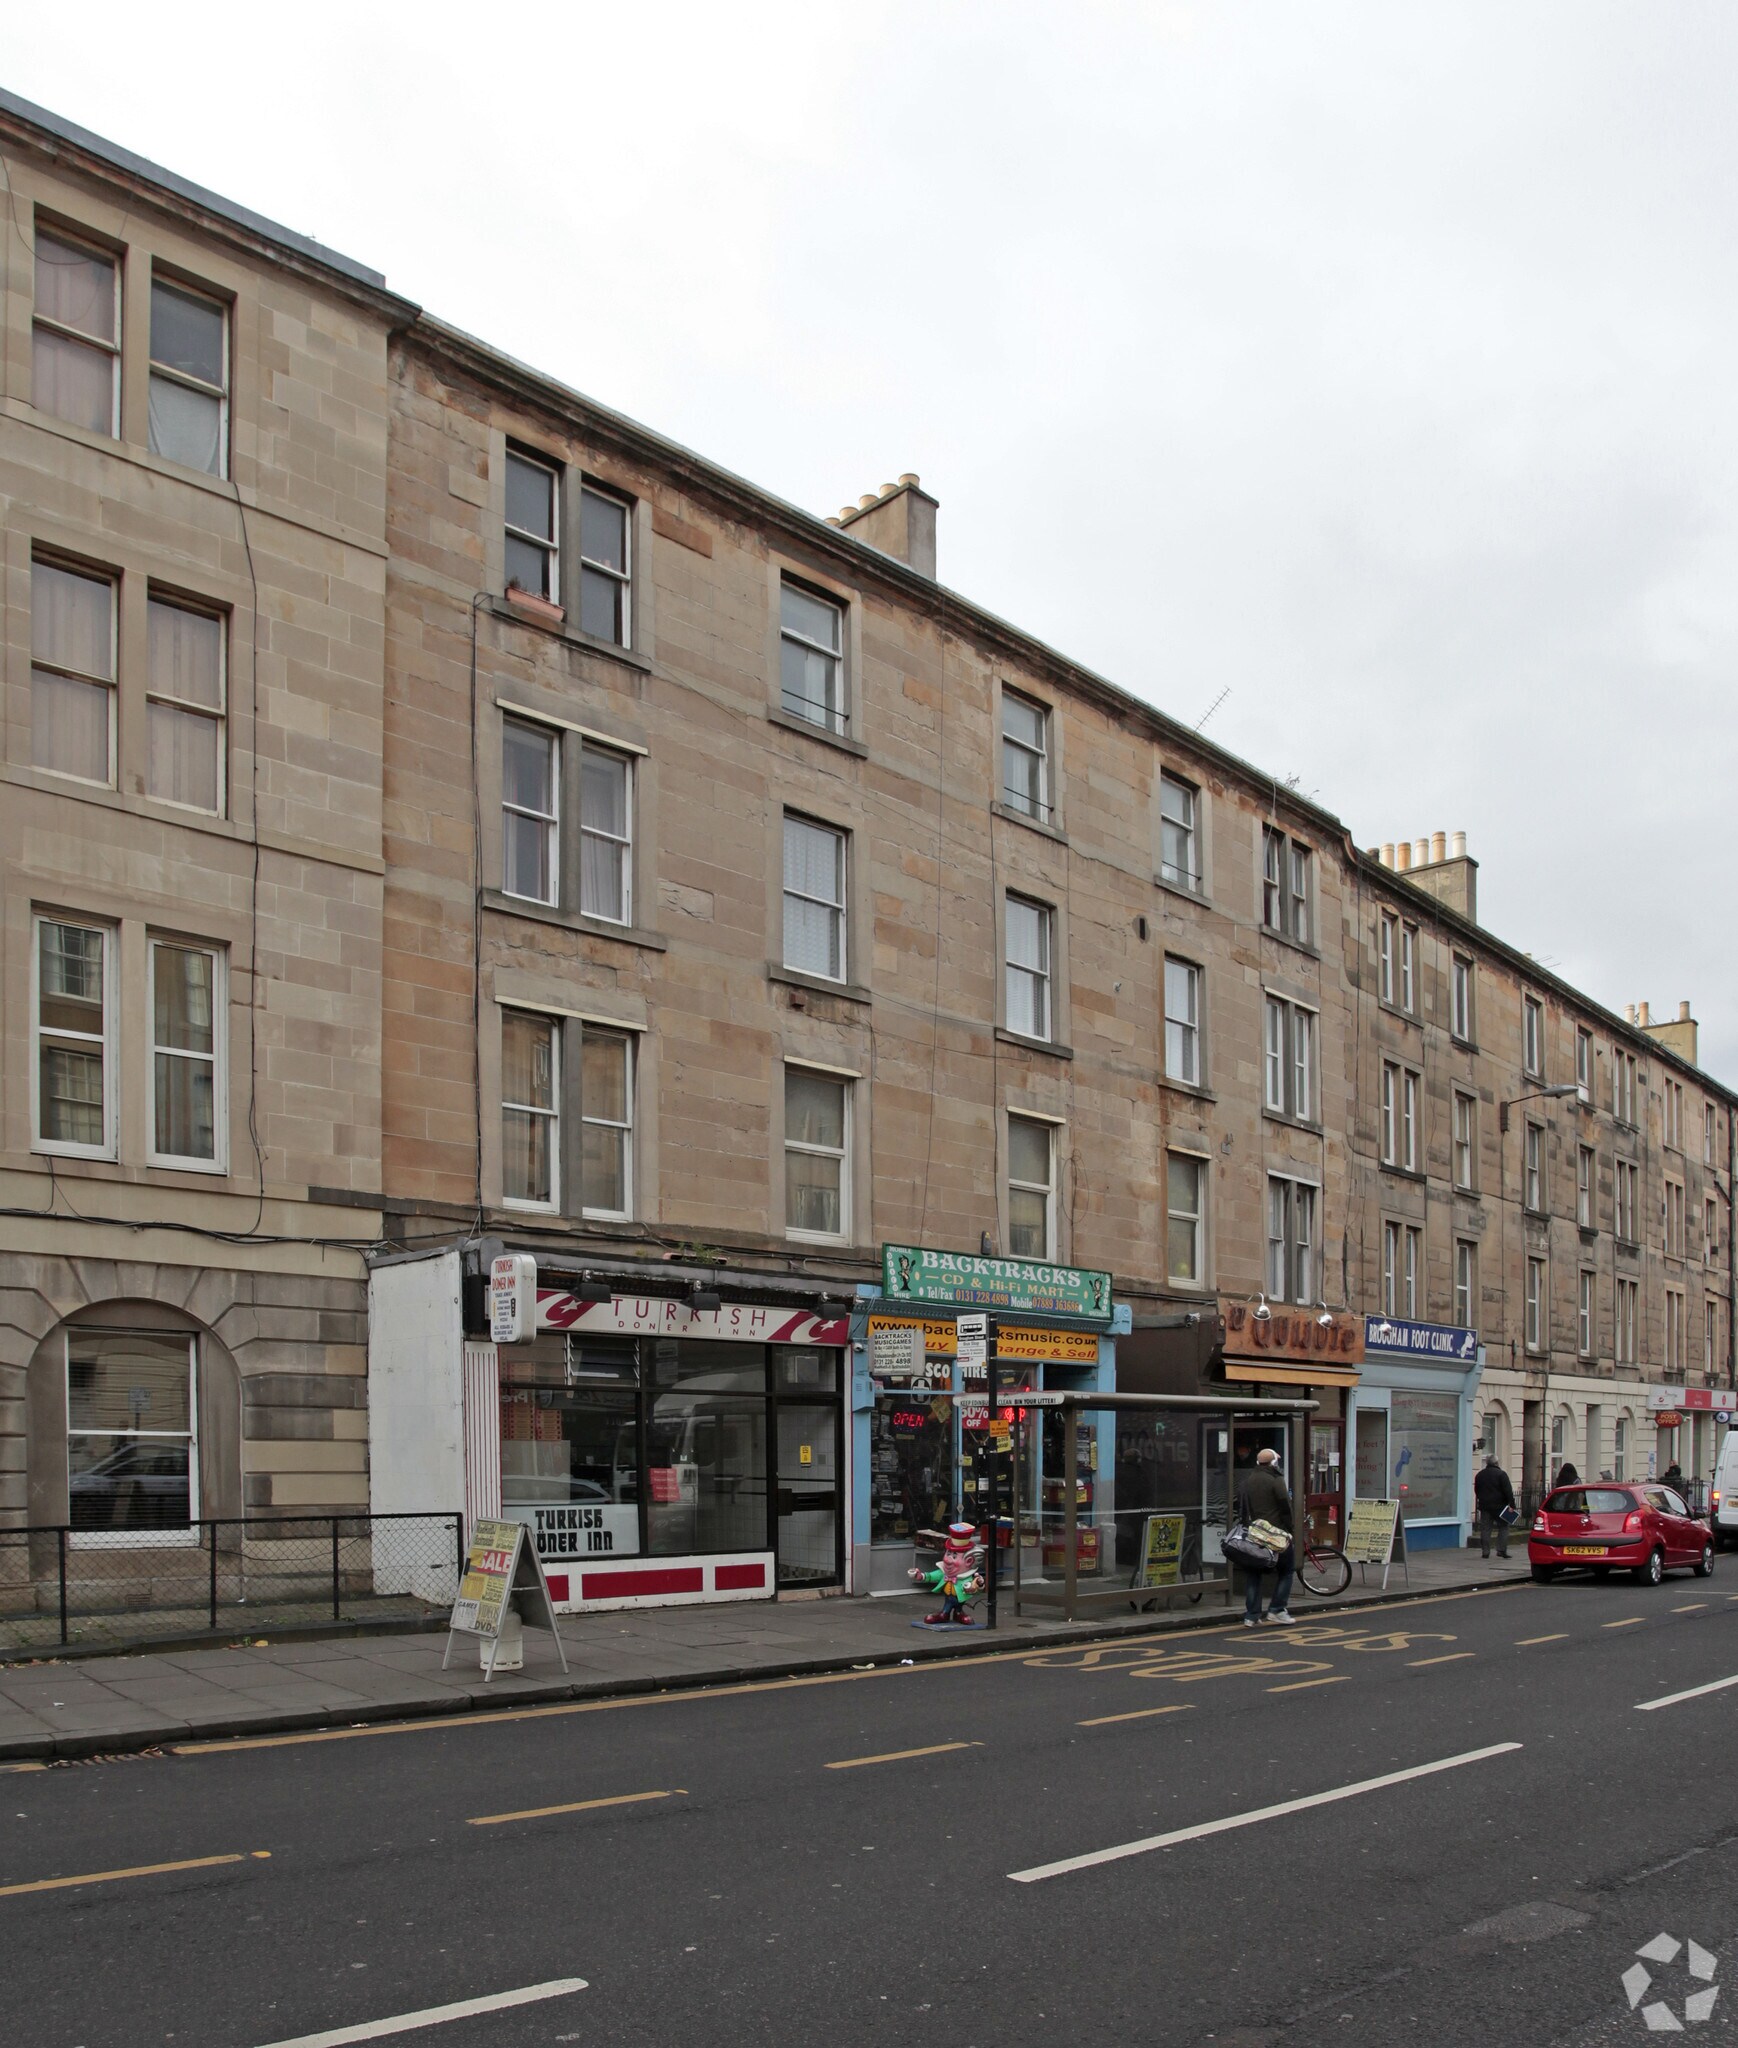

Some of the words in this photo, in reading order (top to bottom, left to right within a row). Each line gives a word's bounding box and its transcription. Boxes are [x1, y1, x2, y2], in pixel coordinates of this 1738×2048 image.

[921, 1250, 1081, 1287] BACKTRACKS
[941, 1273, 964, 1285] CD
[971, 1277, 982, 1289] &
[990, 1279, 1021, 1293] Hi-Fi
[1027, 1285, 1065, 1297] MART
[926, 1285, 953, 1300] Tel/Fax
[955, 1289, 974, 1302] 0131
[975, 1291, 990, 1304] 228
[991, 1292, 1009, 1306] 4898
[1011, 1295, 1033, 1310] Mobile
[611, 1298, 766, 1327] TURKISH
[618, 1320, 688, 1332] DONER
[718, 1327, 756, 1336] INN
[1411, 1329, 1431, 1350] FOOT
[1431, 1331, 1454, 1352] CLINIC
[1050, 1348, 1062, 1356] &
[1067, 1349, 1096, 1358] Sell
[893, 1412, 925, 1427] OPEN
[966, 1419, 981, 1427] OFF
[534, 1508, 603, 1530] TURKISH
[533, 1530, 578, 1553] ÖNER
[587, 1531, 613, 1551] INN
[1566, 1546, 1586, 1554] SK62
[1223, 1626, 1458, 1651] BUS
[1022, 1647, 1334, 1682] STOP
